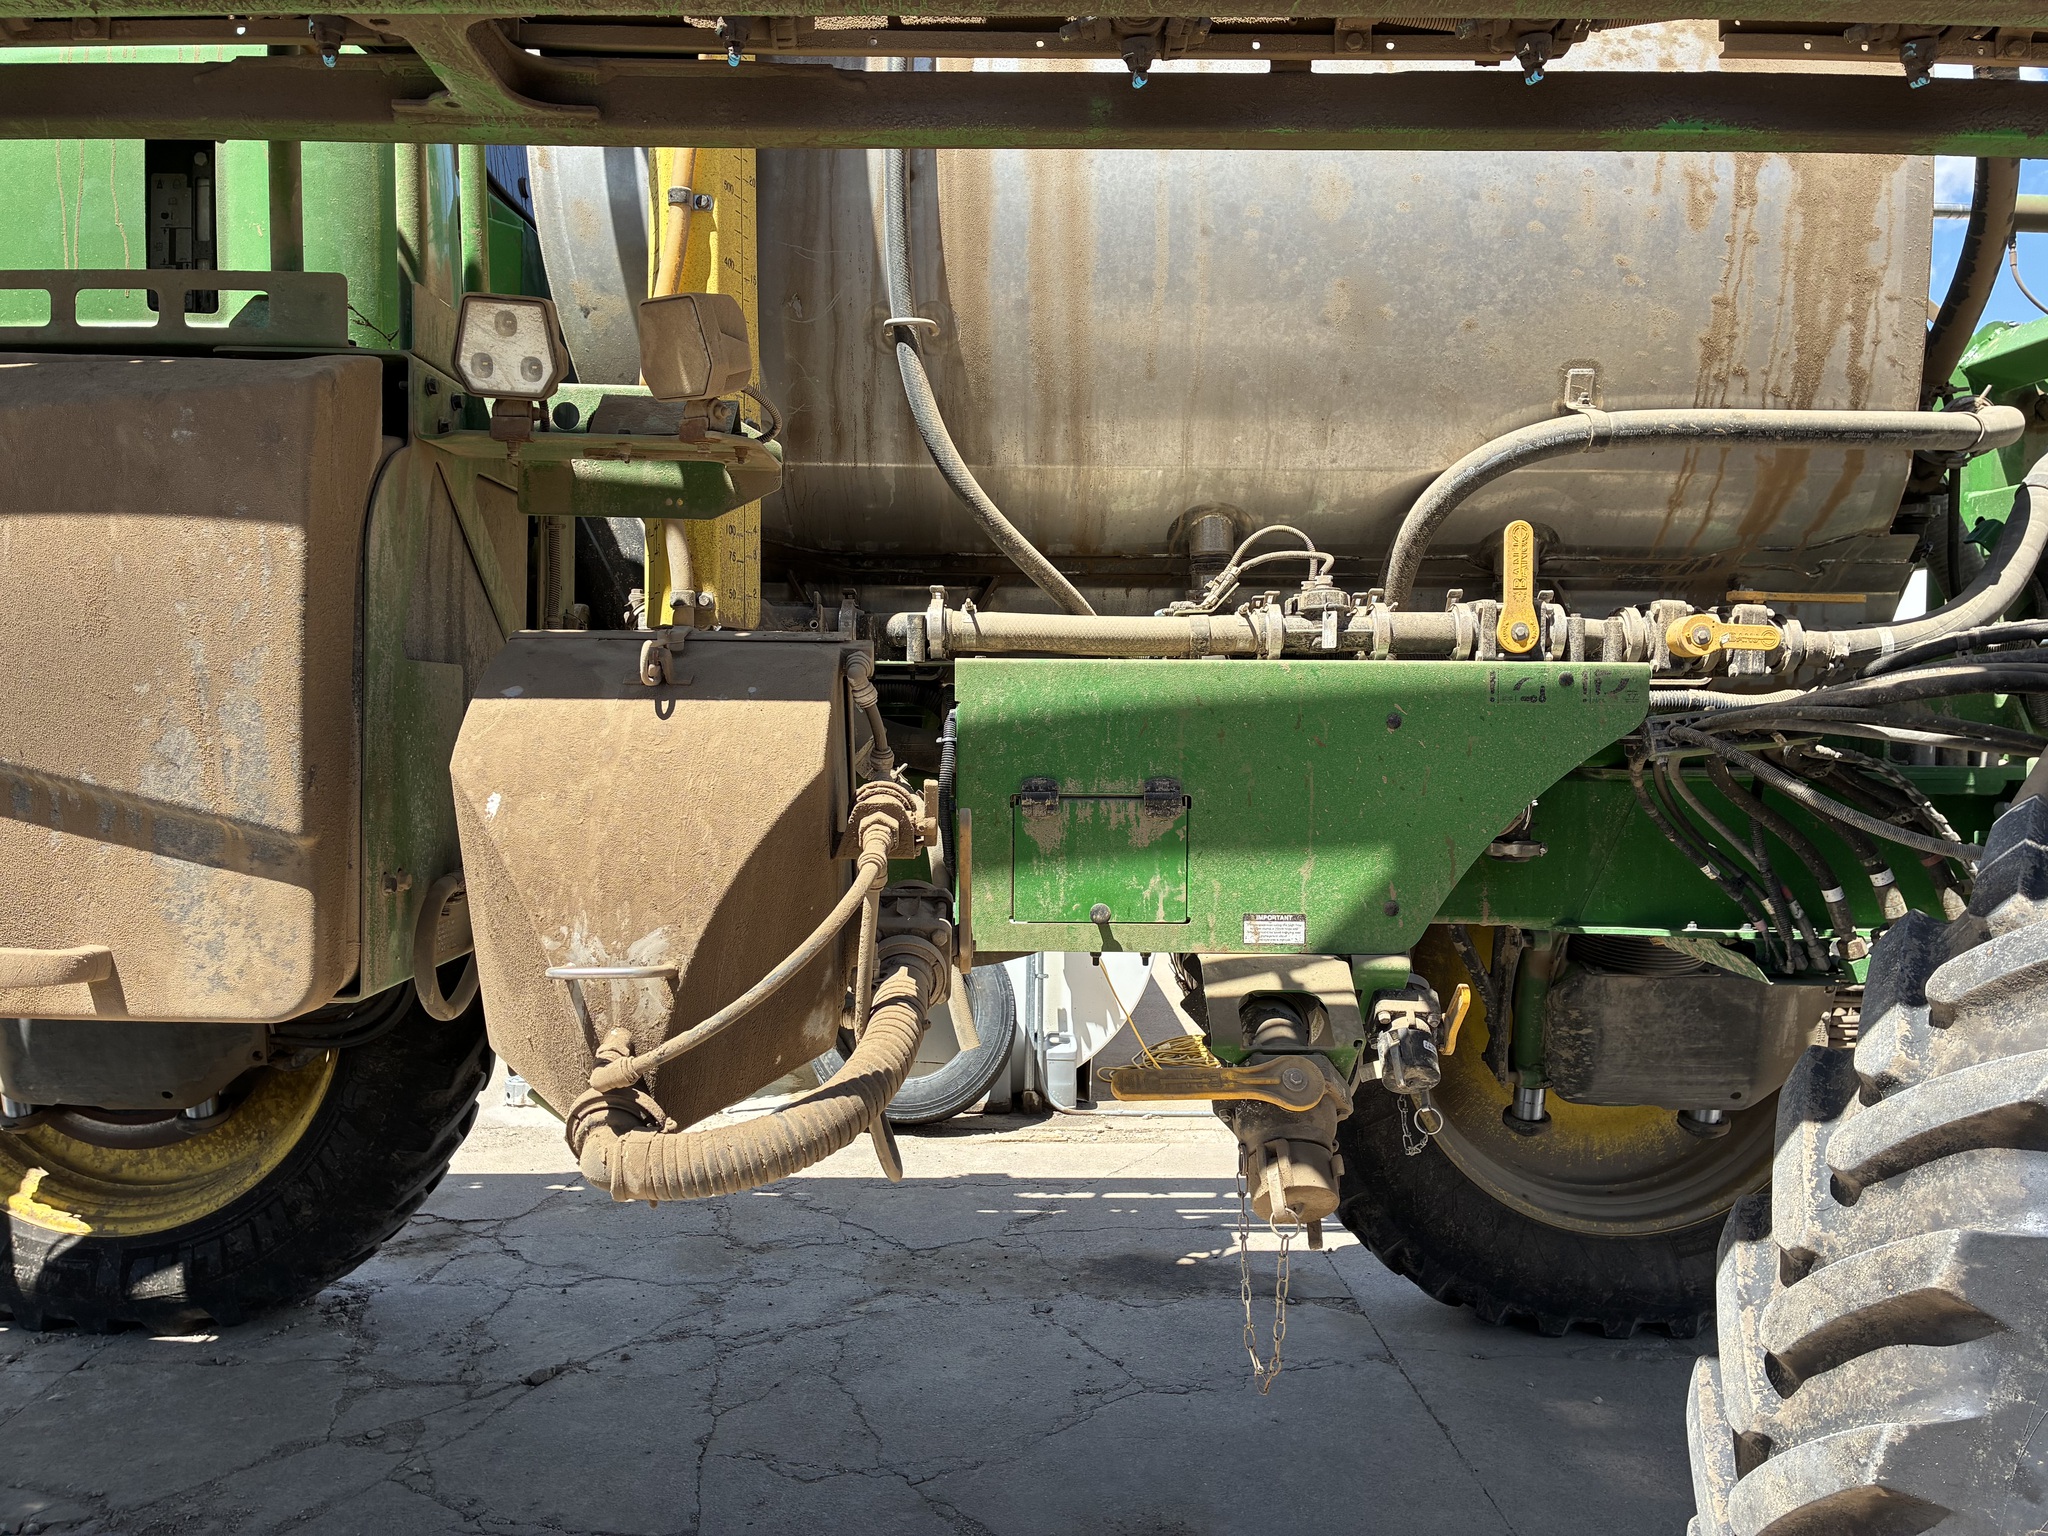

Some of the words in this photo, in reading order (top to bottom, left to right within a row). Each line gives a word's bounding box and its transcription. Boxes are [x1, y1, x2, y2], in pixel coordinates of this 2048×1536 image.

[723, 180, 735, 195] 500
[724, 256, 735, 271] 400
[750, 274, 757, 286] 15
[726, 524, 736, 536] 100
[753, 525, 758, 534] 4
[729, 550, 737, 562] 75
[729, 588, 737, 600] 50
[753, 588, 758, 599] 2
